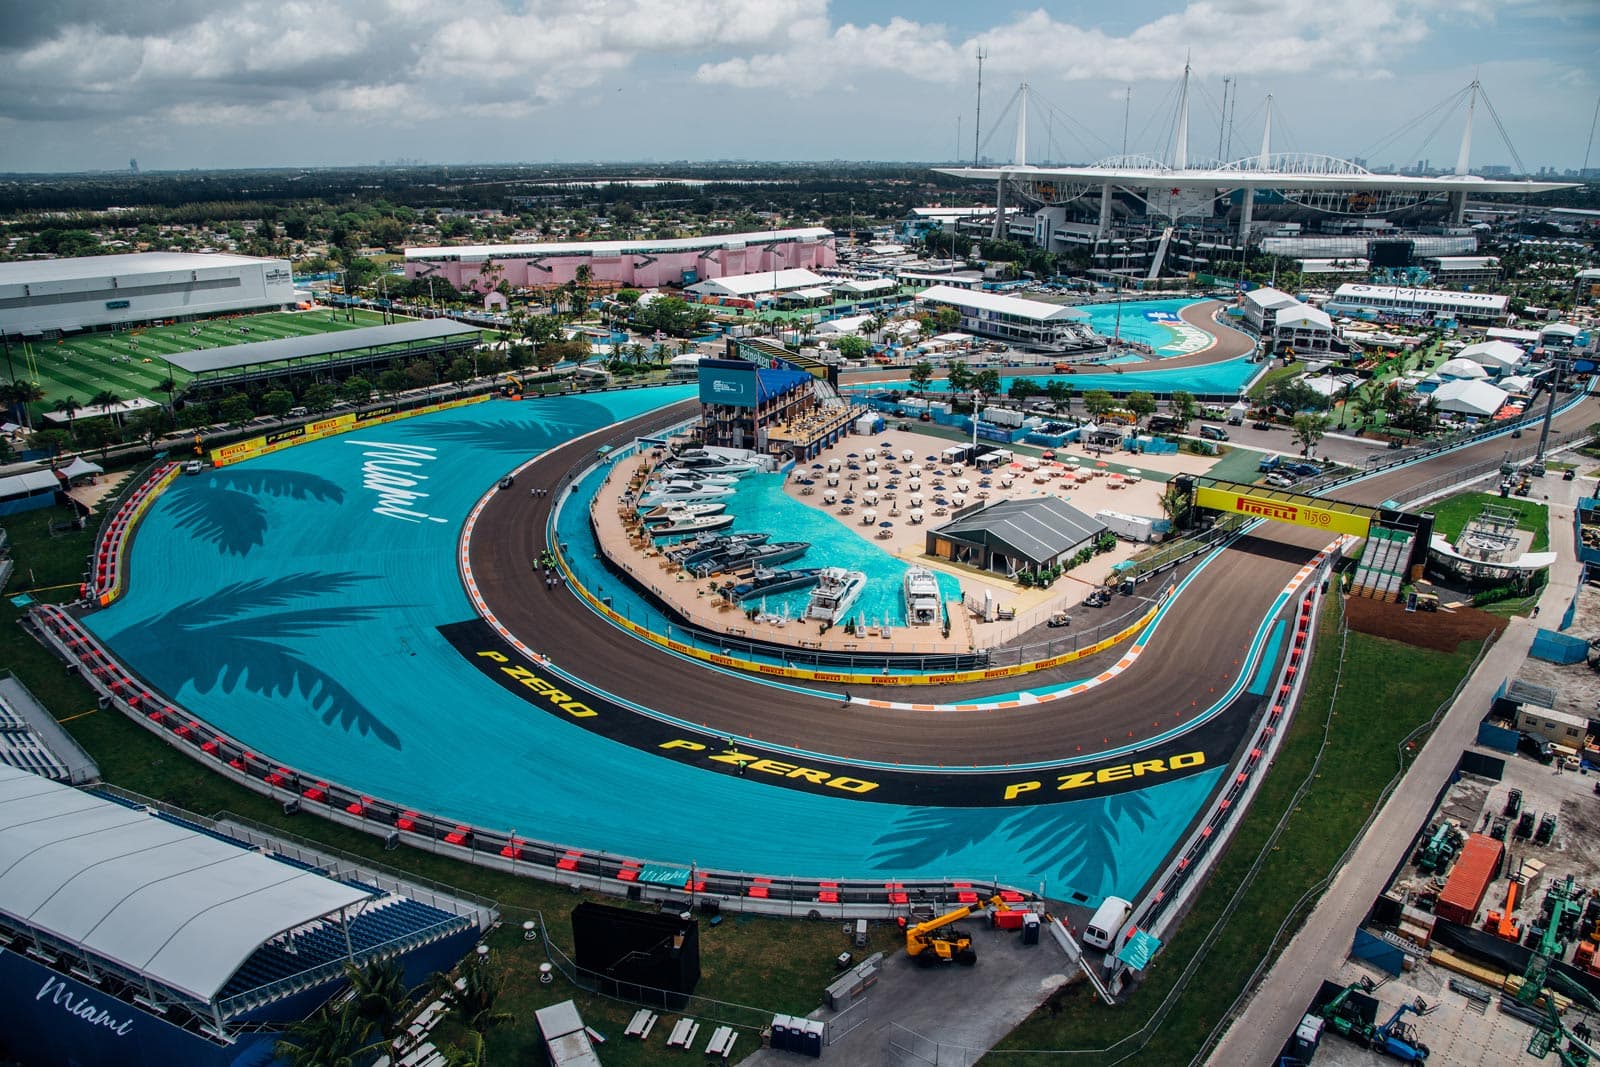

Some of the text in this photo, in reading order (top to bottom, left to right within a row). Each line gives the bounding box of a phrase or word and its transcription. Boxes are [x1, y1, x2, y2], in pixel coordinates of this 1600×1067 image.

[1377, 287, 1493, 301] crypto.com
[740, 345, 770, 369] Heineken
[278, 428, 303, 440] ZERO
[344, 440, 449, 523] Miami
[1236, 497, 1331, 527] PIRELLI 150
[476, 650, 599, 718] P ZERO
[658, 739, 880, 793] P ZERO
[1004, 751, 1206, 800] P ZERO
[35, 976, 134, 1036] Miami
